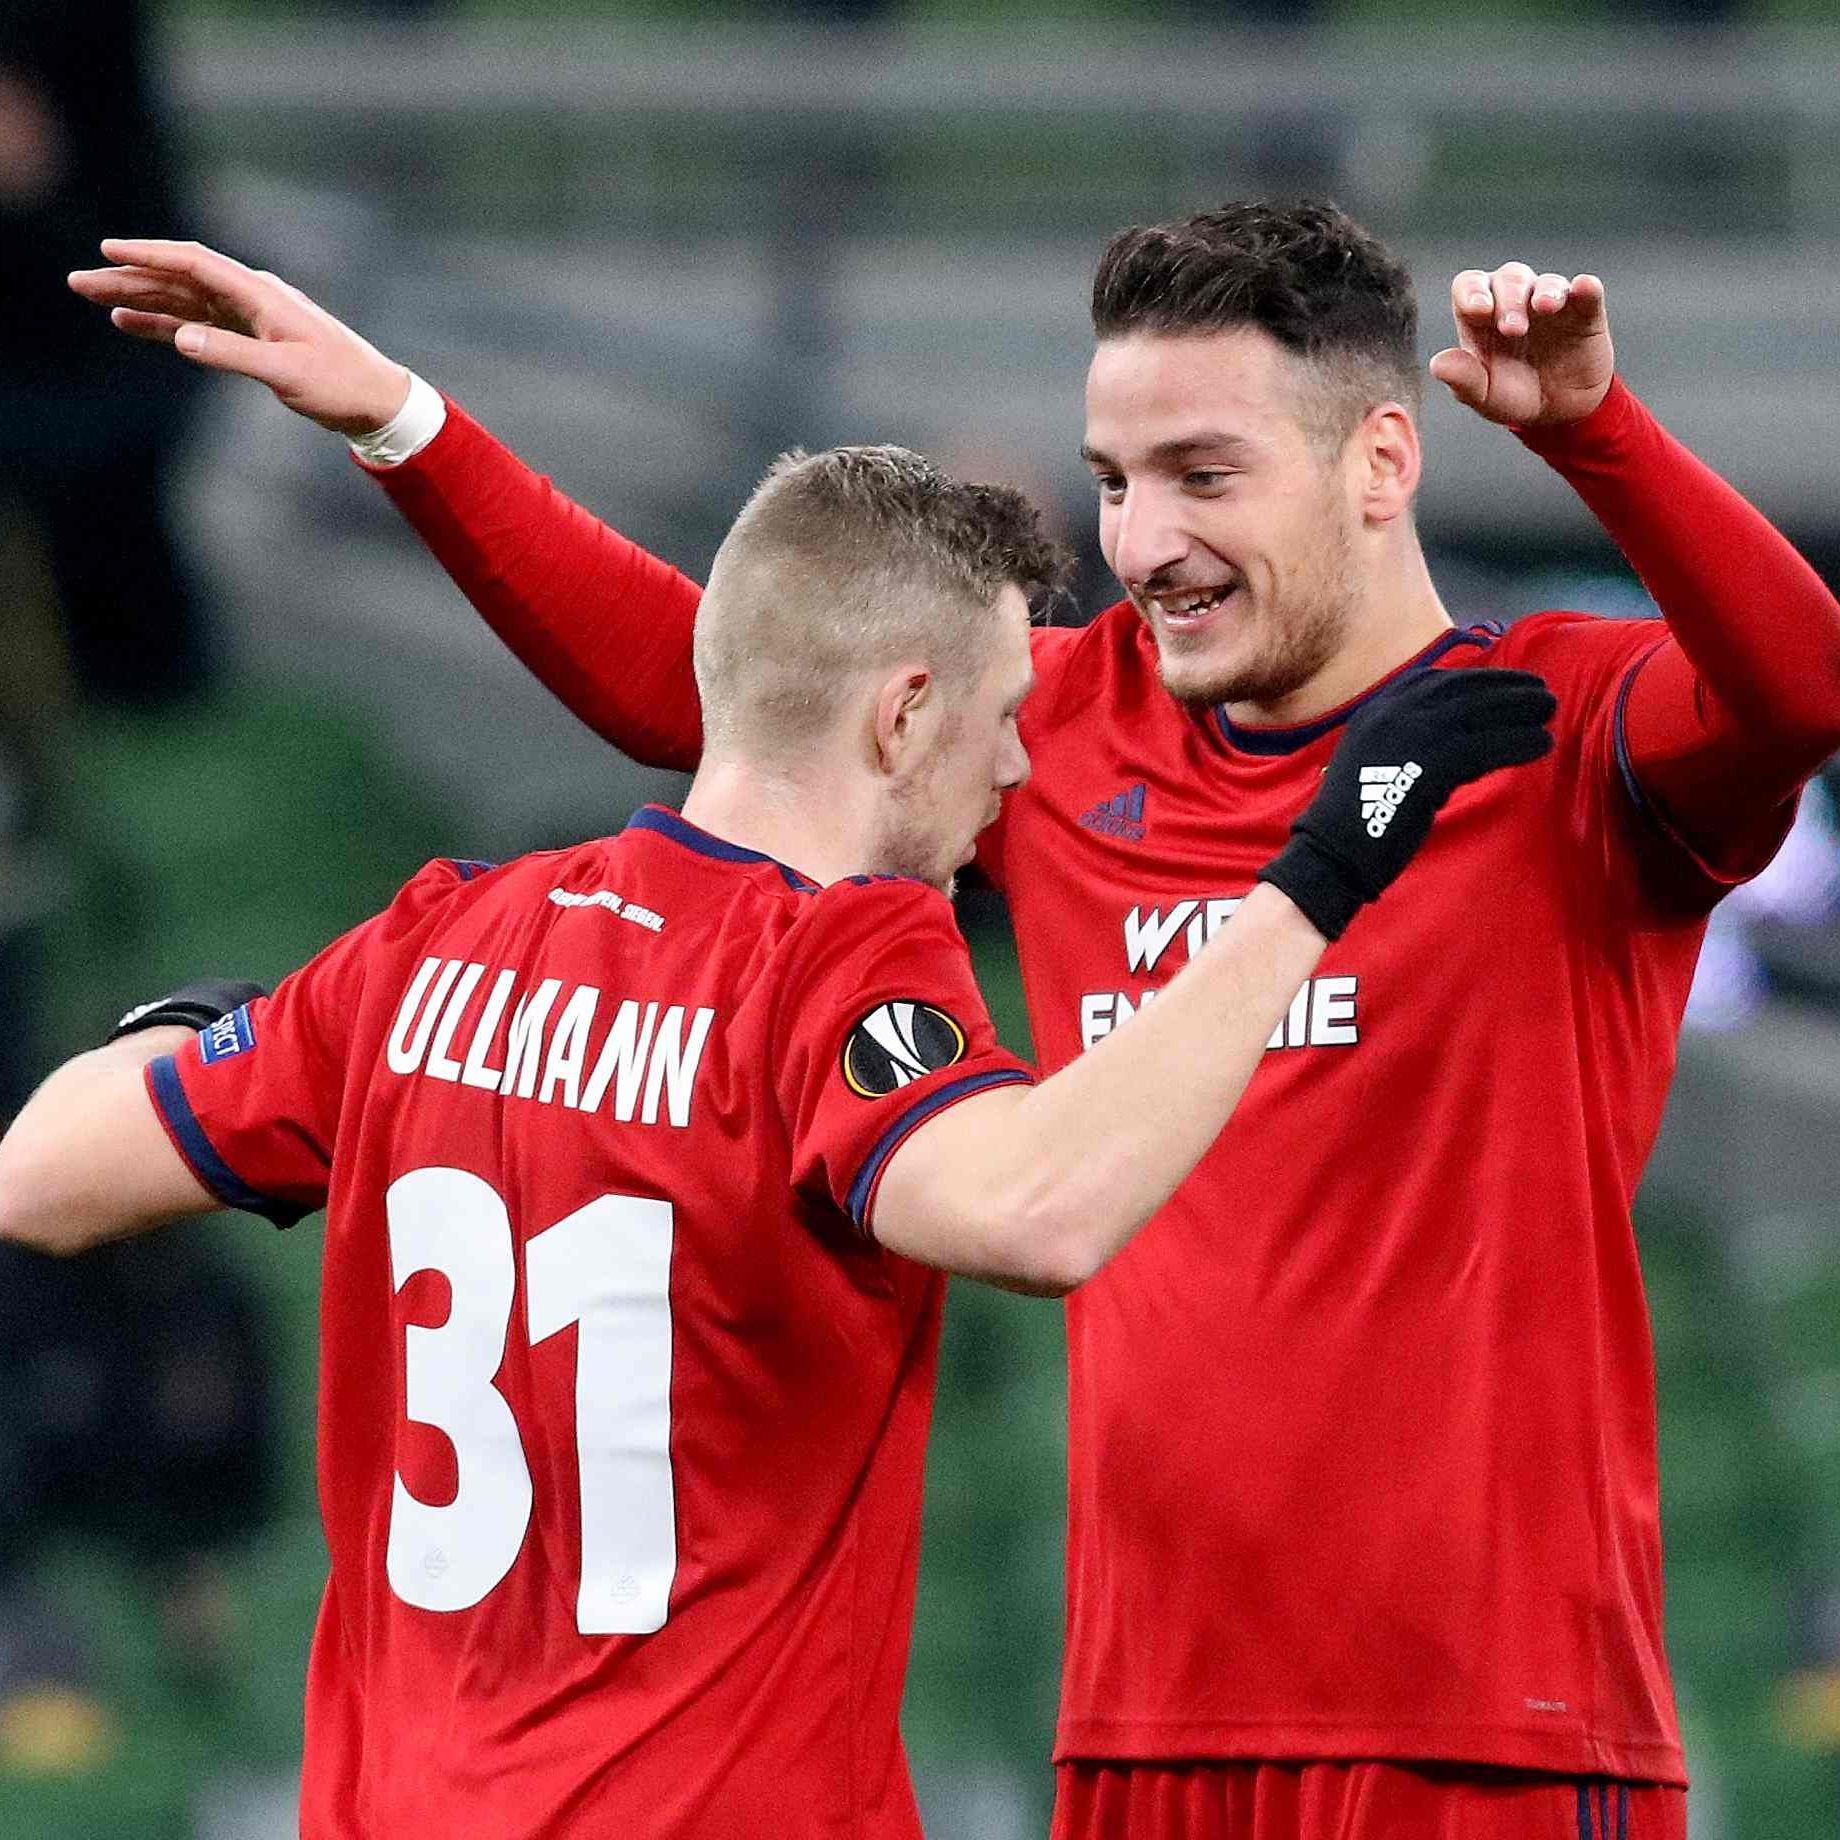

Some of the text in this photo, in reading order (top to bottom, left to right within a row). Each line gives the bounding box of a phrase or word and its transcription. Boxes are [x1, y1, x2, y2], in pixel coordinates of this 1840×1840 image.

[1366, 761, 1423, 838] adidas
[386, 957, 716, 1129] ULLMANN
[385, 1166, 678, 1637] 31
